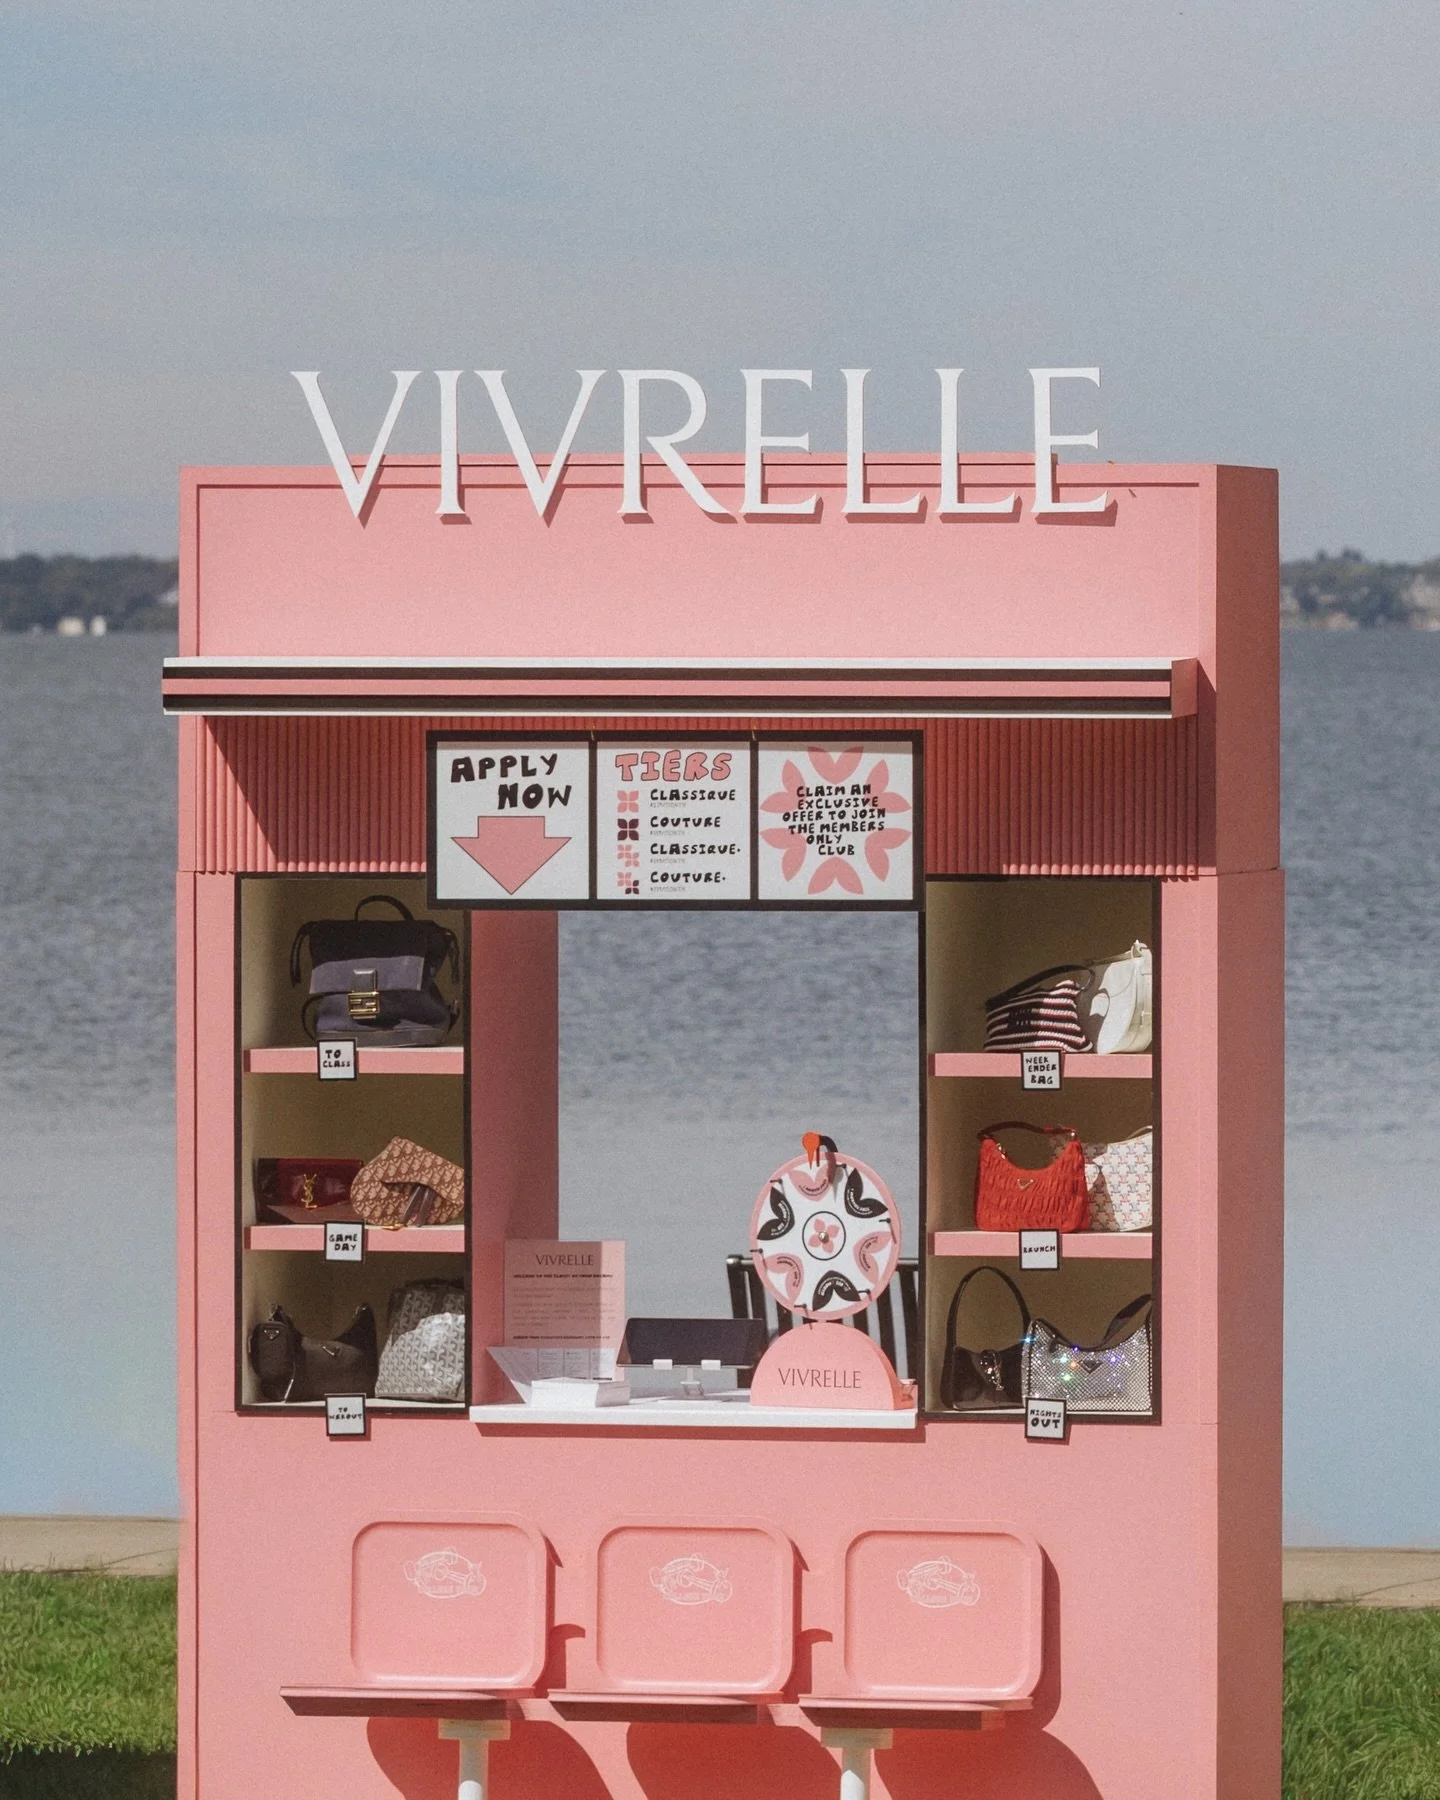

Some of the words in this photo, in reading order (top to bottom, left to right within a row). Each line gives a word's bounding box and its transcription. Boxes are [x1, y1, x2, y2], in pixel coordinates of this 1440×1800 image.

[290, 367, 1109, 518] VIVRELLE
[450, 753, 558, 783] APPLY
[615, 749, 733, 782] TIERS
[497, 782, 573, 810] NOW
[650, 788, 736, 801] CLASSIQUE
[796, 785, 846, 797] CLAIM
[850, 783, 871, 795] AN
[797, 796, 879, 810] EXCLUSIVE
[782, 810, 824, 822] OFFER
[828, 809, 847, 820] TO
[851, 807, 886, 820] JOIN
[650, 815, 721, 828] COUTURE
[788, 822, 815, 835] THE
[820, 820, 885, 833] MEMBERS
[806, 834, 842, 845] ONLY
[818, 844, 855, 856] CLUB
[325, 1049, 341, 1059] TO
[1025, 1056, 1049, 1064] WEEK
[322, 1060, 351, 1068] CLASS
[1028, 1064, 1057, 1072] ENDER
[1030, 1074, 1054, 1084] BAG
[328, 1233, 358, 1242] GAME
[334, 1243, 356, 1251] DAY
[536, 1254, 594, 1266] VIVRELLE
[778, 1368, 862, 1389] VIVRELLE
[1030, 1409, 1062, 1418] NIGHTS
[1031, 1417, 1061, 1429] OUT
